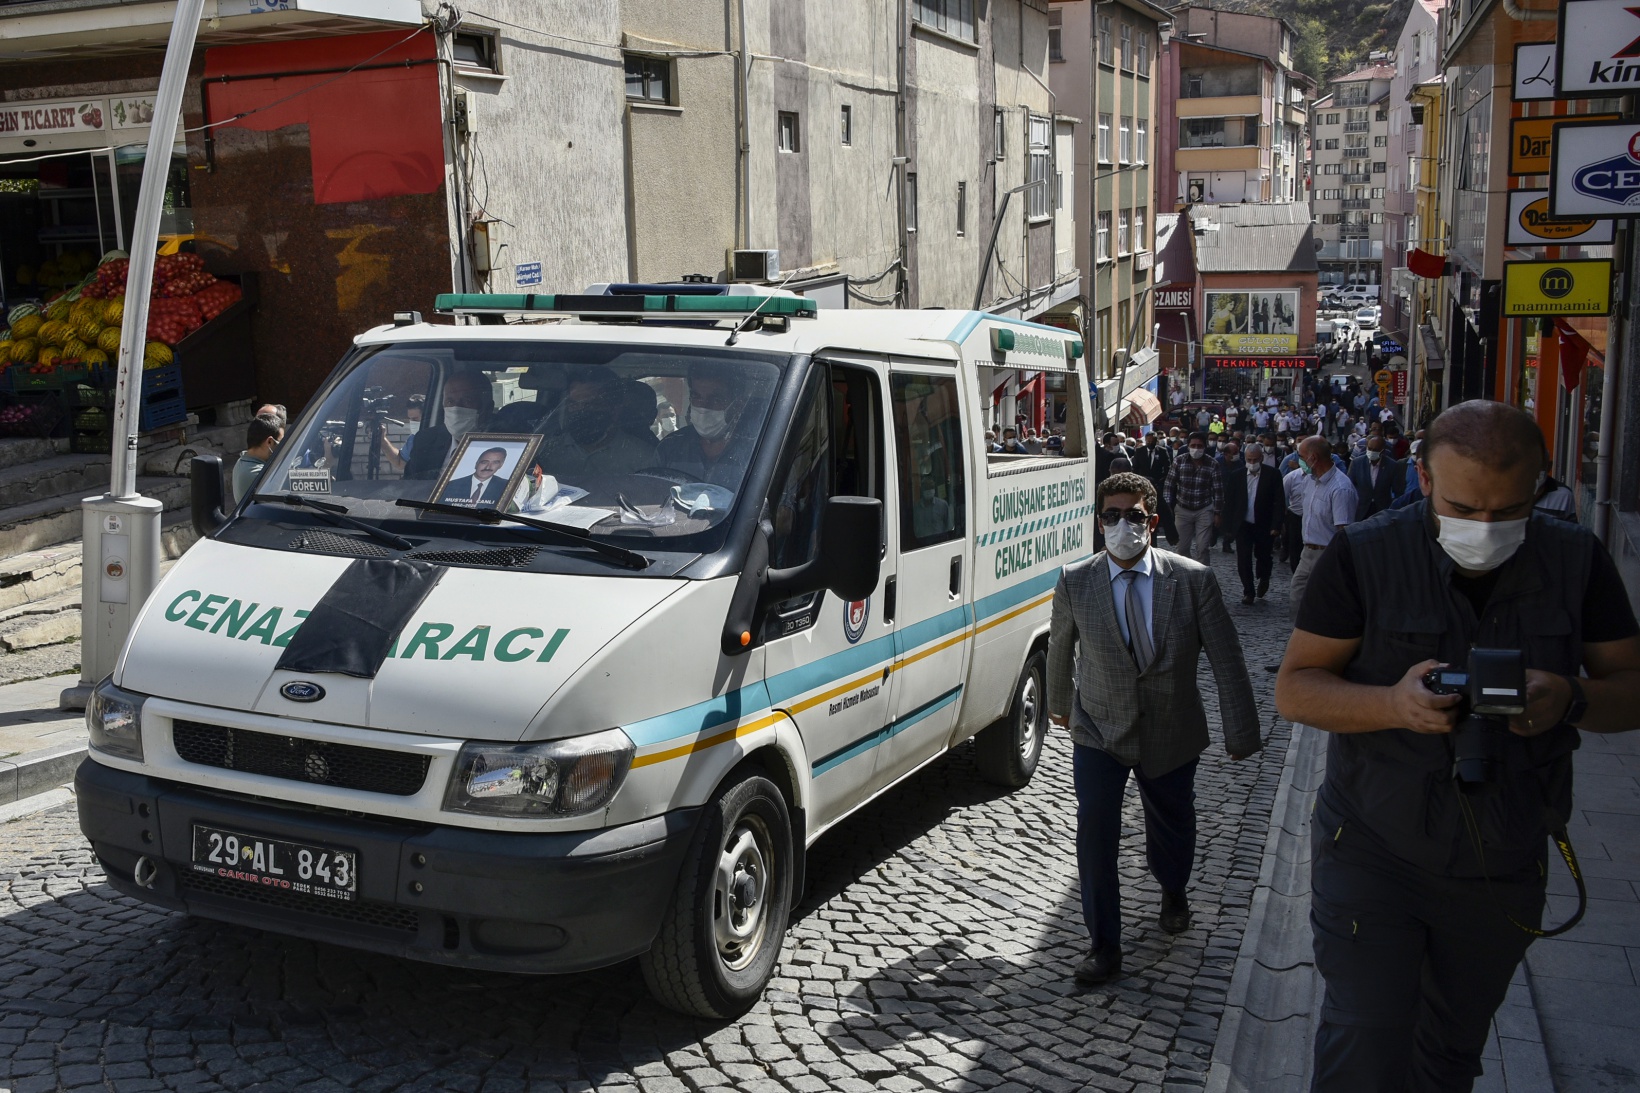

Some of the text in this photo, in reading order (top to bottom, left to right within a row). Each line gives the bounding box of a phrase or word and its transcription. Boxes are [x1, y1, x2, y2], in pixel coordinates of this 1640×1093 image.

[21, 107, 76, 130] TİCARET
[1544, 276, 1569, 290] m
[1512, 298, 1601, 312] mammamia
[1238, 337, 1290, 345] GÜLCAN
[1216, 358, 1306, 368] TEKNİK SERVİS
[292, 479, 328, 491] GÖREVLİ
[992, 472, 1086, 525] GÜMÜŞHANE BELEDİYESİ
[995, 522, 1083, 580] CENAZE NAKİL ARACI
[164, 589, 571, 663] CENAZ RACI
[289, 684, 311, 696] Ford
[208, 832, 350, 887] 29 AL 843
[261, 876, 291, 889] OTO
